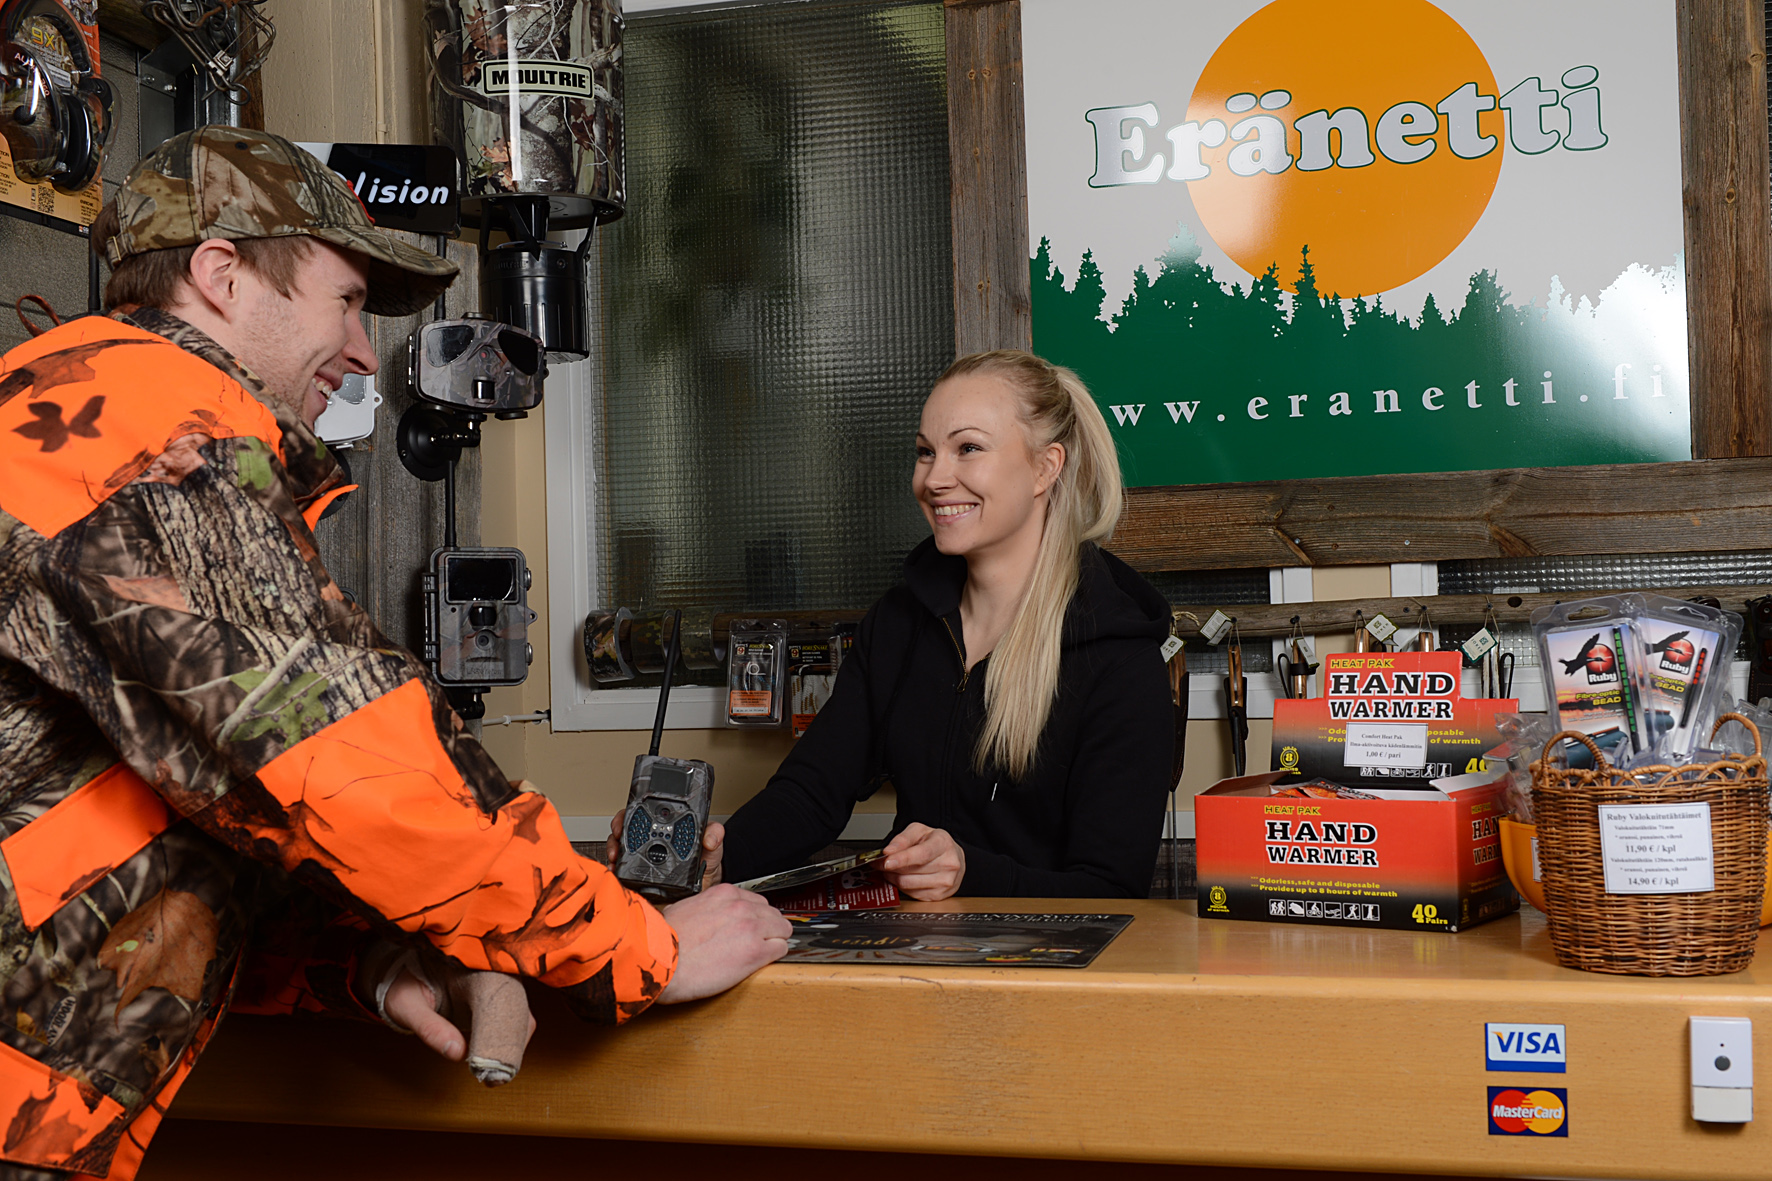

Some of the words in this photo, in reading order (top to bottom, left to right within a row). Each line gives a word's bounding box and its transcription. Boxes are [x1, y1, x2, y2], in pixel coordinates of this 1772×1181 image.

[31, 26, 56, 50] 9X
[491, 69, 587, 89] MOULTRIE
[1086, 65, 1609, 188] Eränetti
[354, 171, 449, 205] ision
[1331, 659, 1364, 668] HEAT
[1368, 658, 1395, 668] PAK
[1661, 660, 1690, 675] Ruby
[1329, 672, 1456, 696] HAND
[1589, 673, 1617, 683] Ruby
[1576, 689, 1621, 700] Fibre-optic
[1655, 681, 1685, 693] BEAD
[1592, 696, 1622, 706] BEAD
[1328, 699, 1454, 720] WARMER
[1264, 805, 1294, 815] HEAT
[1297, 806, 1321, 816] PAK
[1607, 814, 1627, 822] Ruby
[1629, 812, 1702, 820] Valokuitutähtäimet
[1265, 820, 1378, 845] HAND
[1472, 814, 1507, 841] HAN
[1266, 844, 1379, 868] WARMER
[1626, 845, 1647, 853] 11,90
[1662, 845, 1676, 854] kpl
[1260, 878, 1315, 886] Odorless,safe
[1334, 881, 1380, 889] disposable
[1260, 884, 1295, 892] Provides
[1628, 878, 1650, 886] 14,90
[1665, 878, 1679, 887] kpl
[1412, 904, 1438, 923] 40
[1426, 917, 1448, 925] Pairs
[1491, 1031, 1561, 1054] VISA
[1492, 1105, 1563, 1120] MasterCard
